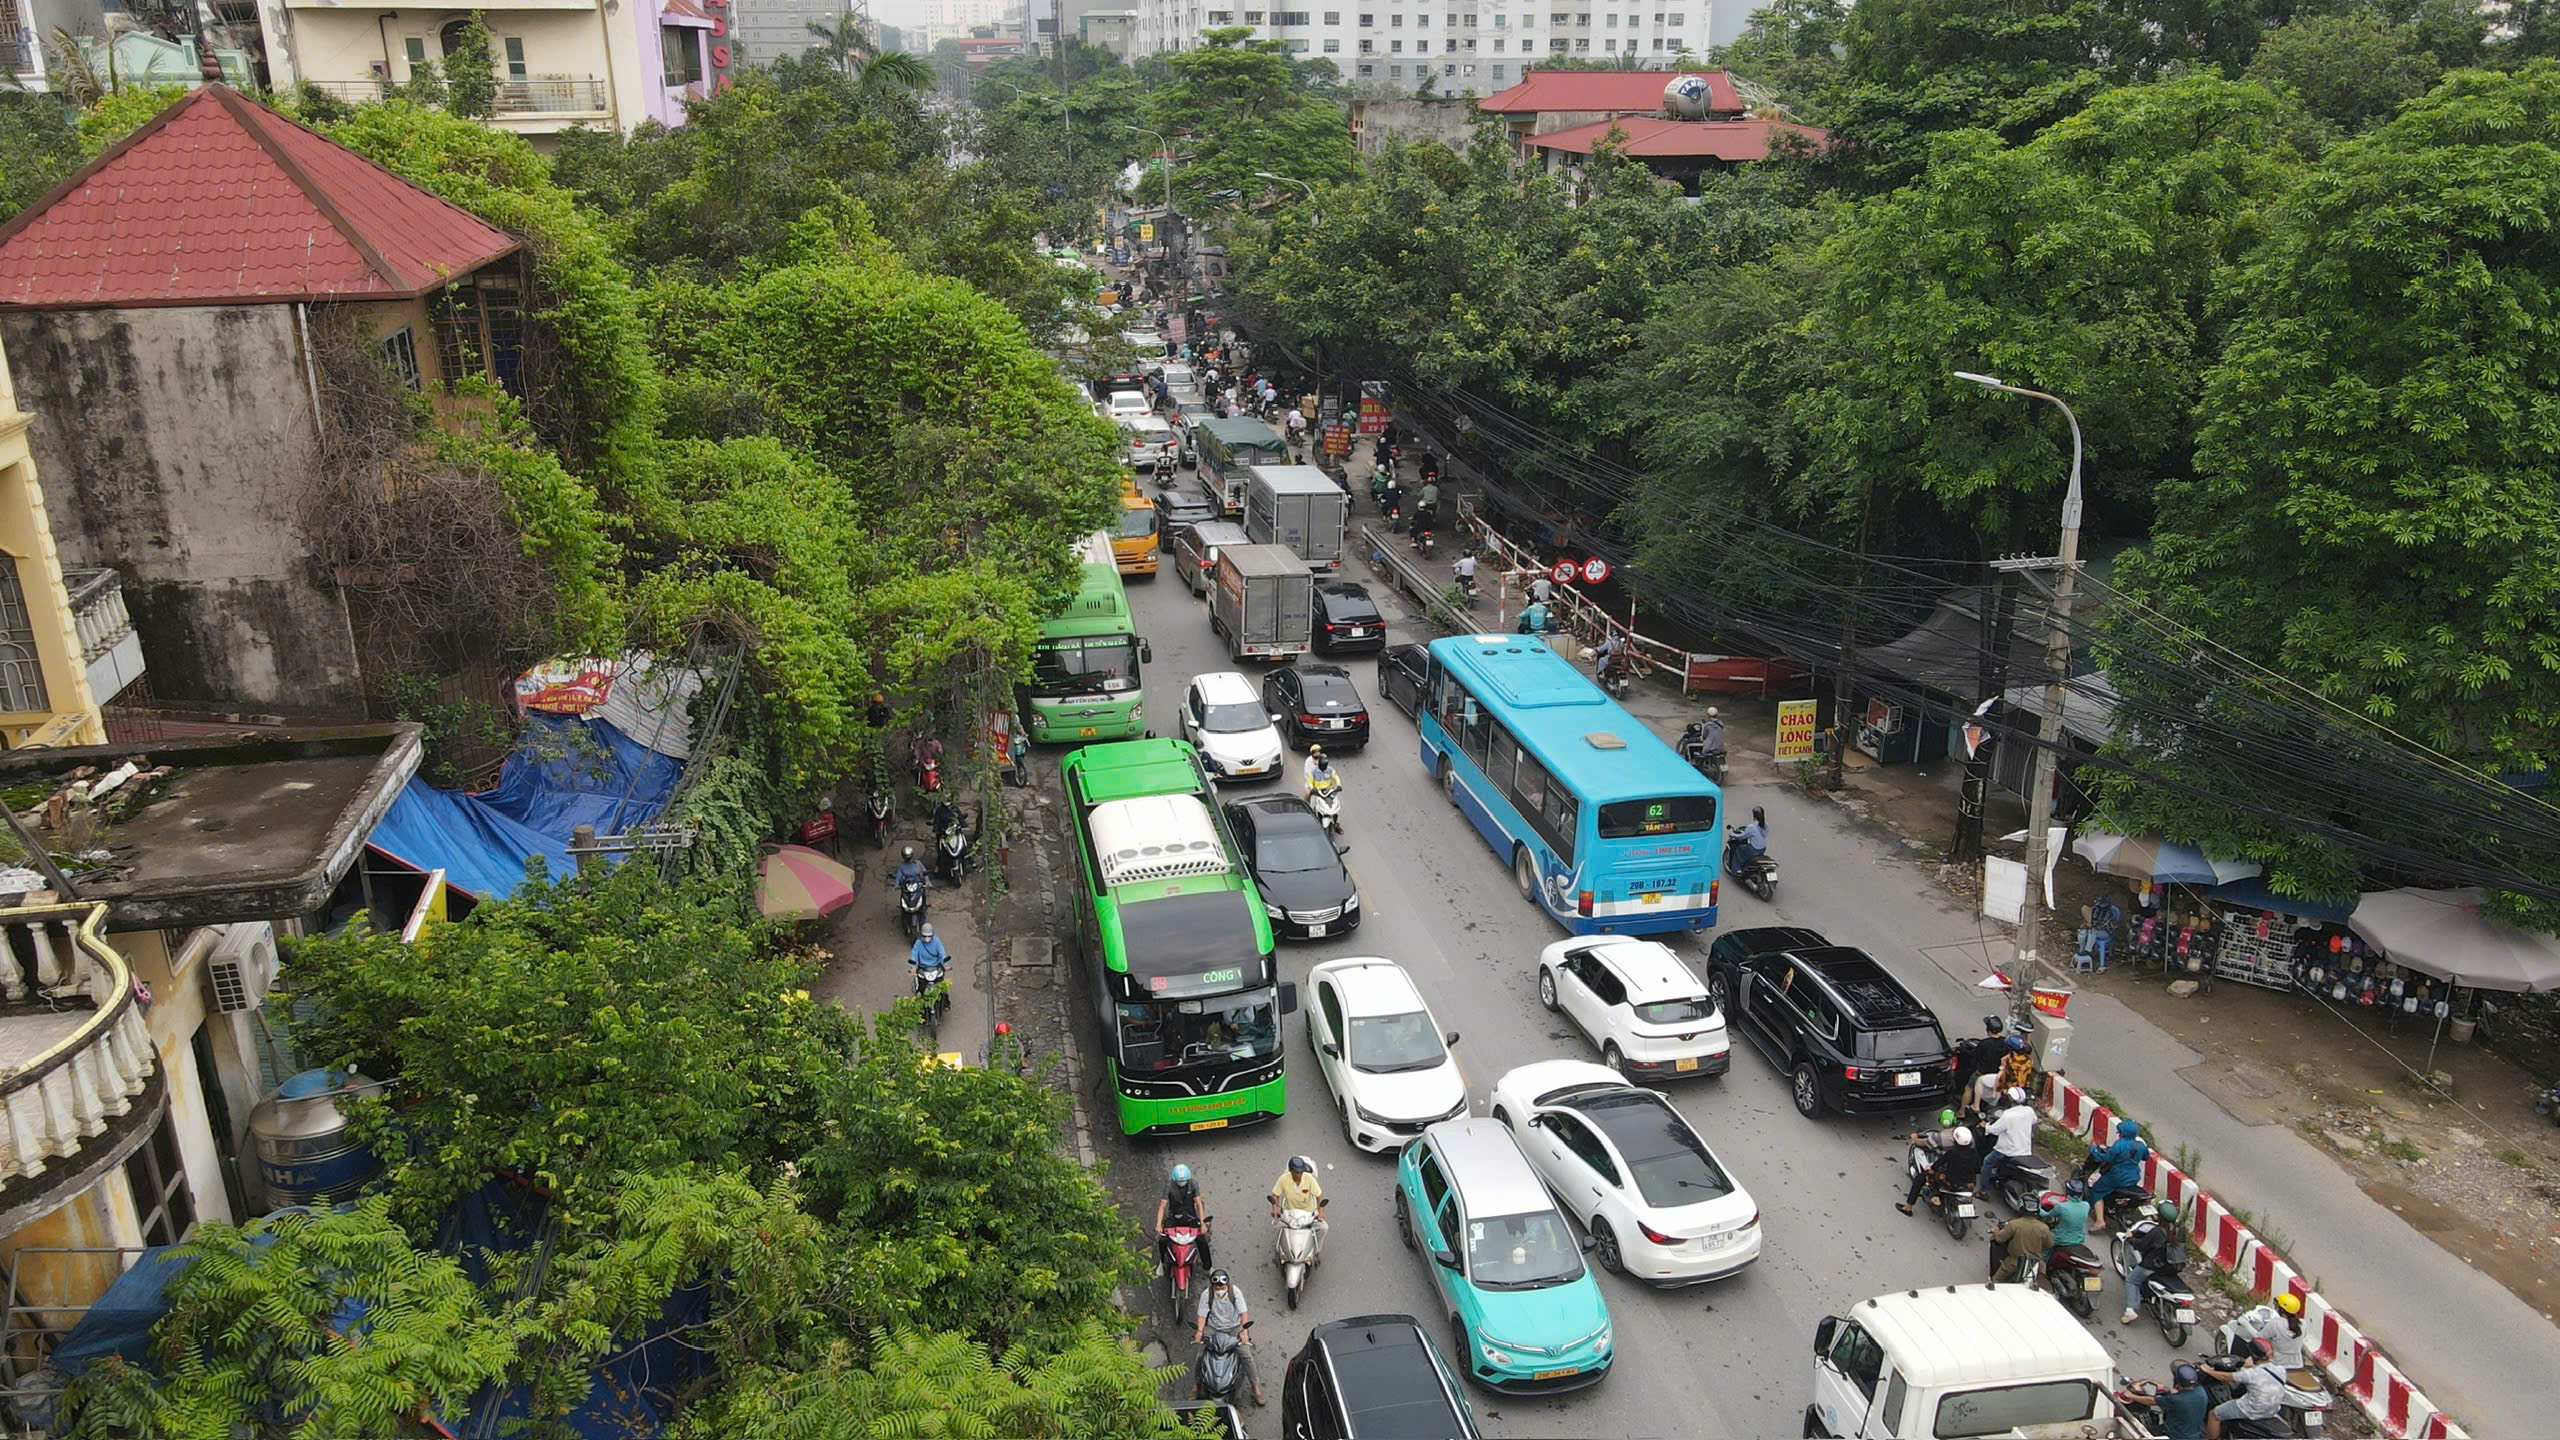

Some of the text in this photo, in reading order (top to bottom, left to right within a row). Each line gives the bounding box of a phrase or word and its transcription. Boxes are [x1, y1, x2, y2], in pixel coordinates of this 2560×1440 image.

[1779, 727, 1813, 743] LÒNG
[1649, 804, 1663, 816] 62
[1203, 970, 1234, 984] CÔNG
